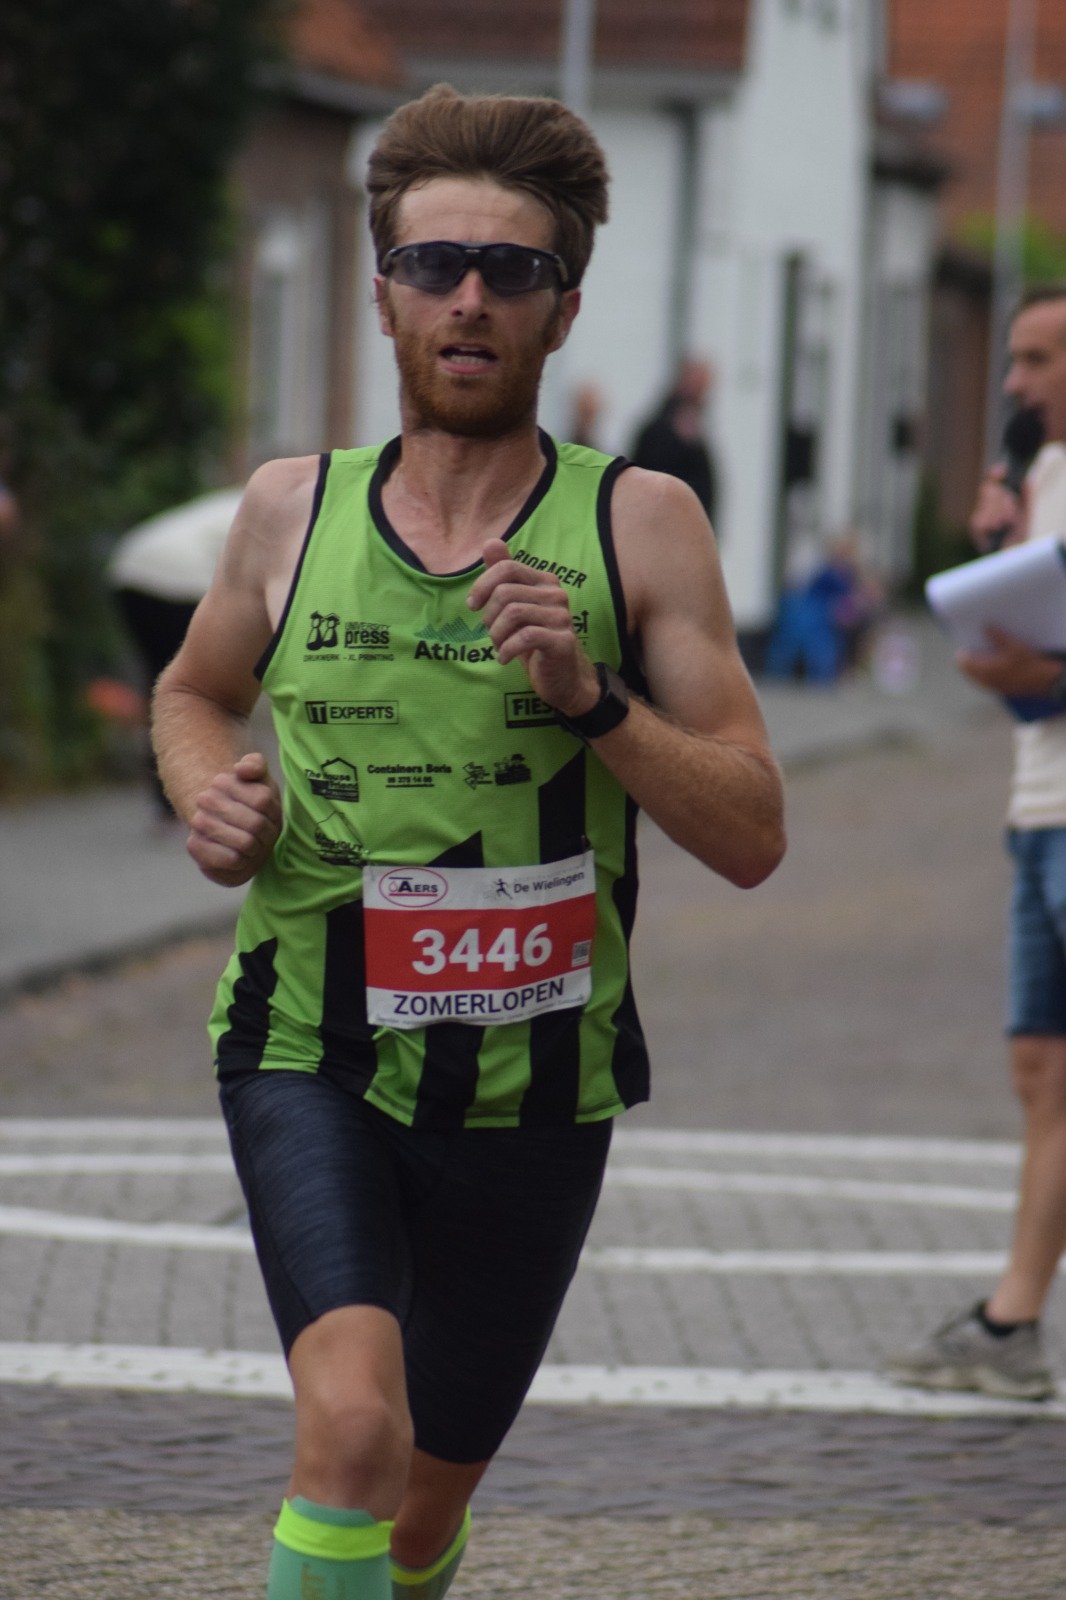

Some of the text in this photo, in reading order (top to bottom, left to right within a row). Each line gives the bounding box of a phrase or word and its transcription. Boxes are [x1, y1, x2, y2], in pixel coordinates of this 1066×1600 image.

[345, 630, 390, 648] press
[358, 653, 395, 662] PRINTING
[413, 640, 496, 663] Athlex
[330, 706, 394, 719] EXPERTS
[367, 763, 423, 774] Containers
[398, 885, 438, 898] AERS
[513, 872, 585, 894] De Wielingen
[411, 922, 553, 976] 3446
[393, 977, 565, 1016] ZOMERLOPEN
